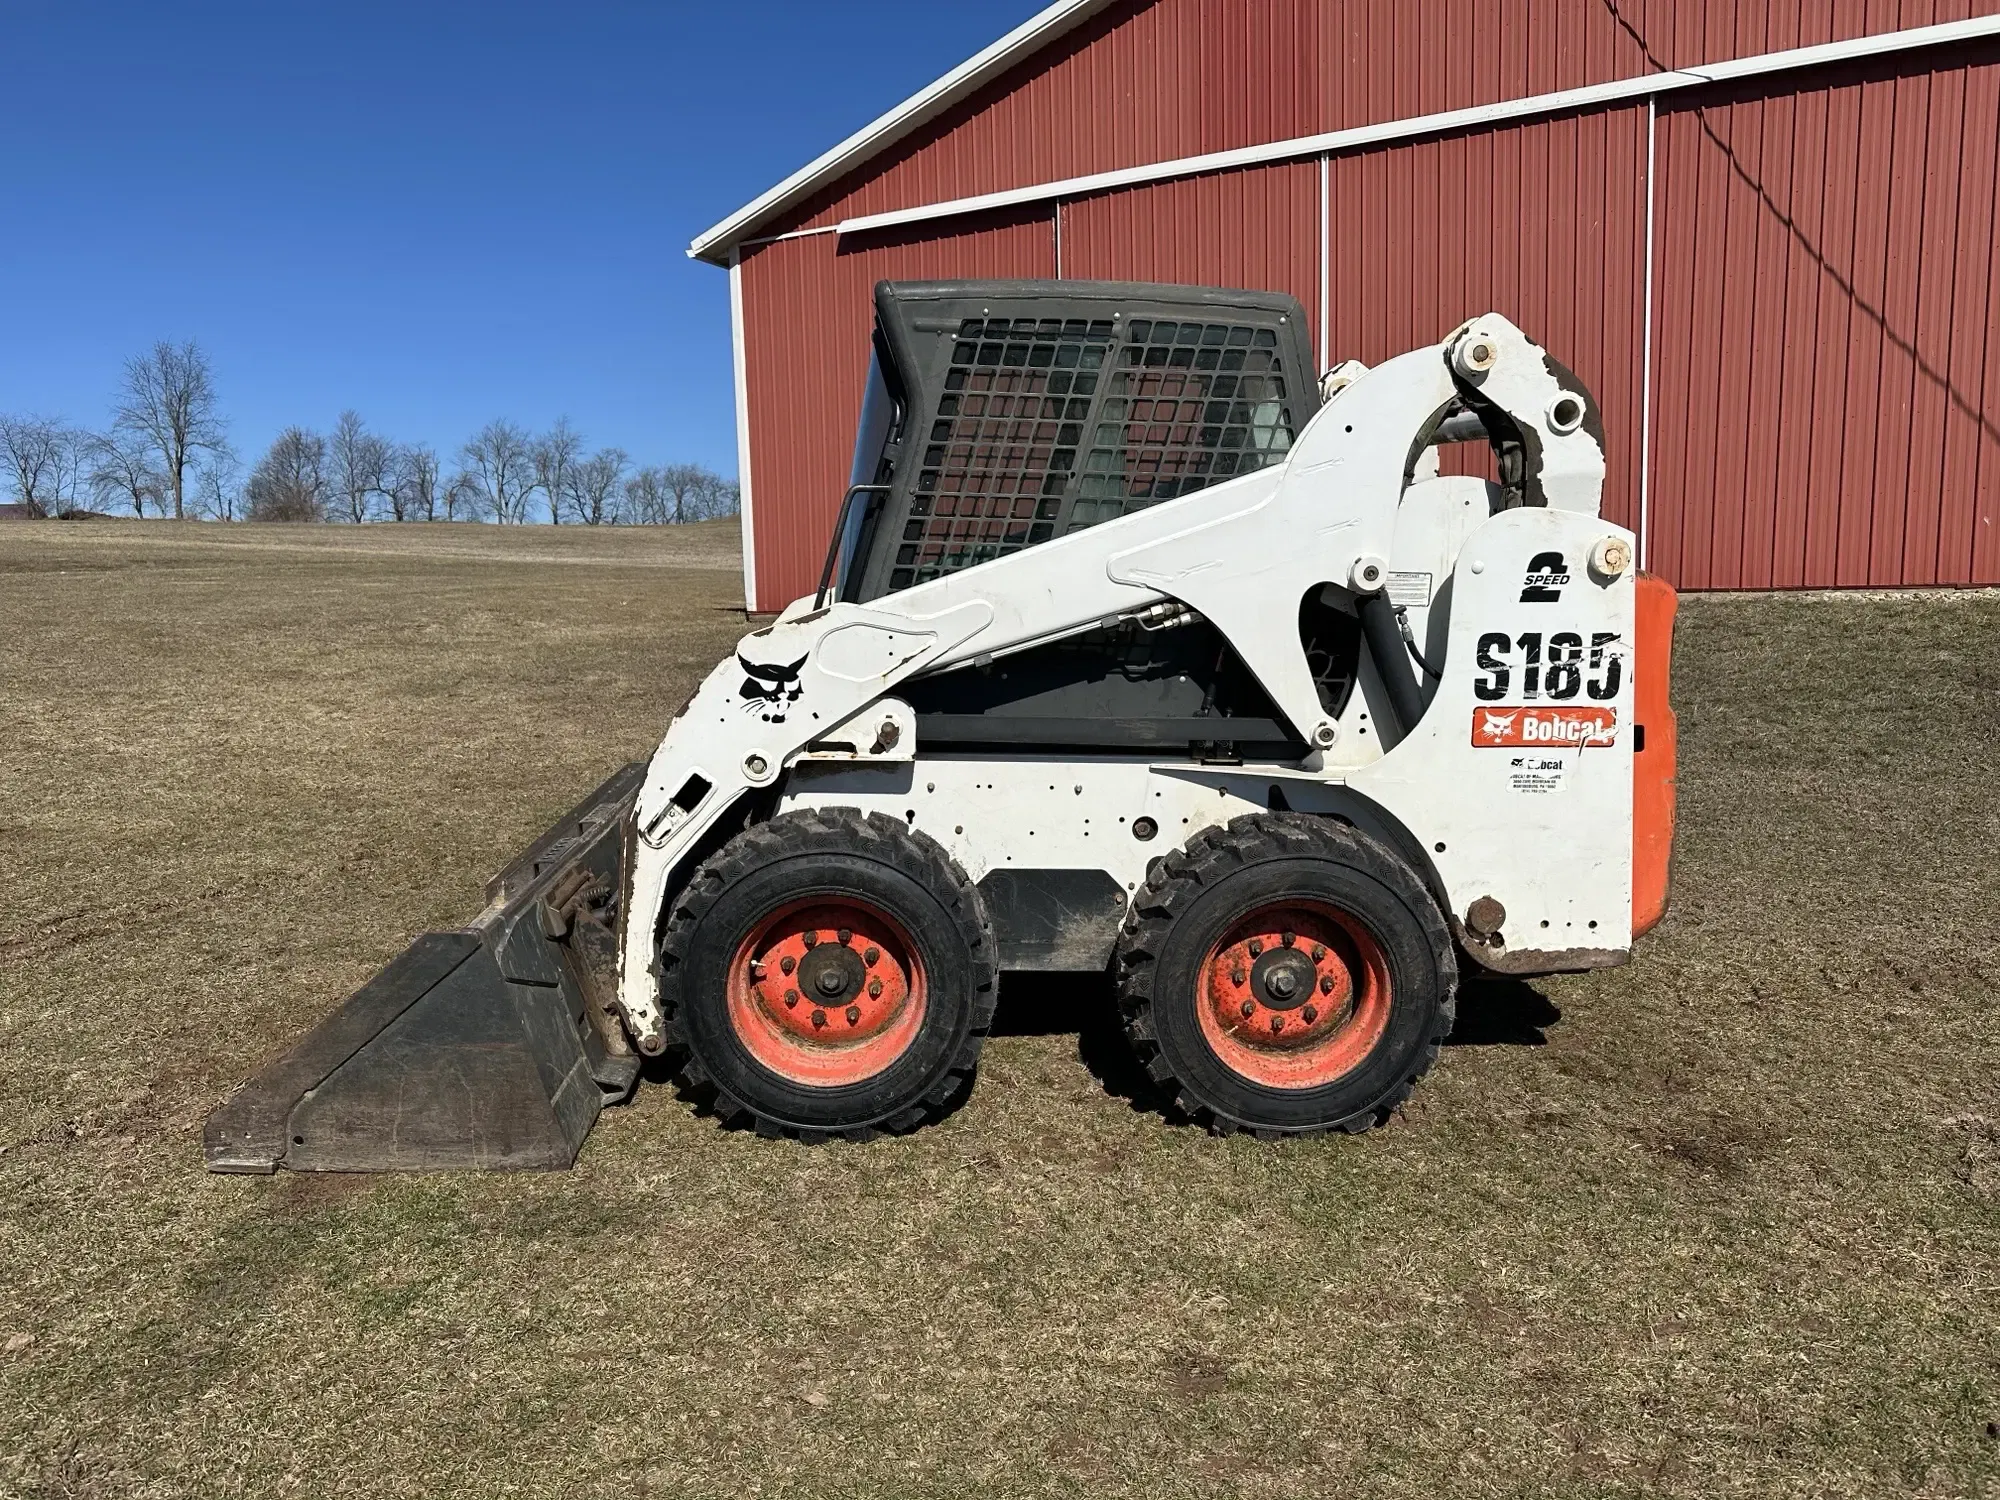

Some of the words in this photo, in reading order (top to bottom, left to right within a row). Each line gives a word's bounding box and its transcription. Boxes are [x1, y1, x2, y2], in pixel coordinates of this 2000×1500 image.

[1519, 551, 1568, 602] 2
[1524, 574, 1570, 585] SPEED
[1474, 632, 1622, 701] S185
[1522, 716, 1606, 741] Bobcat
[1528, 760, 1563, 770] bcat
